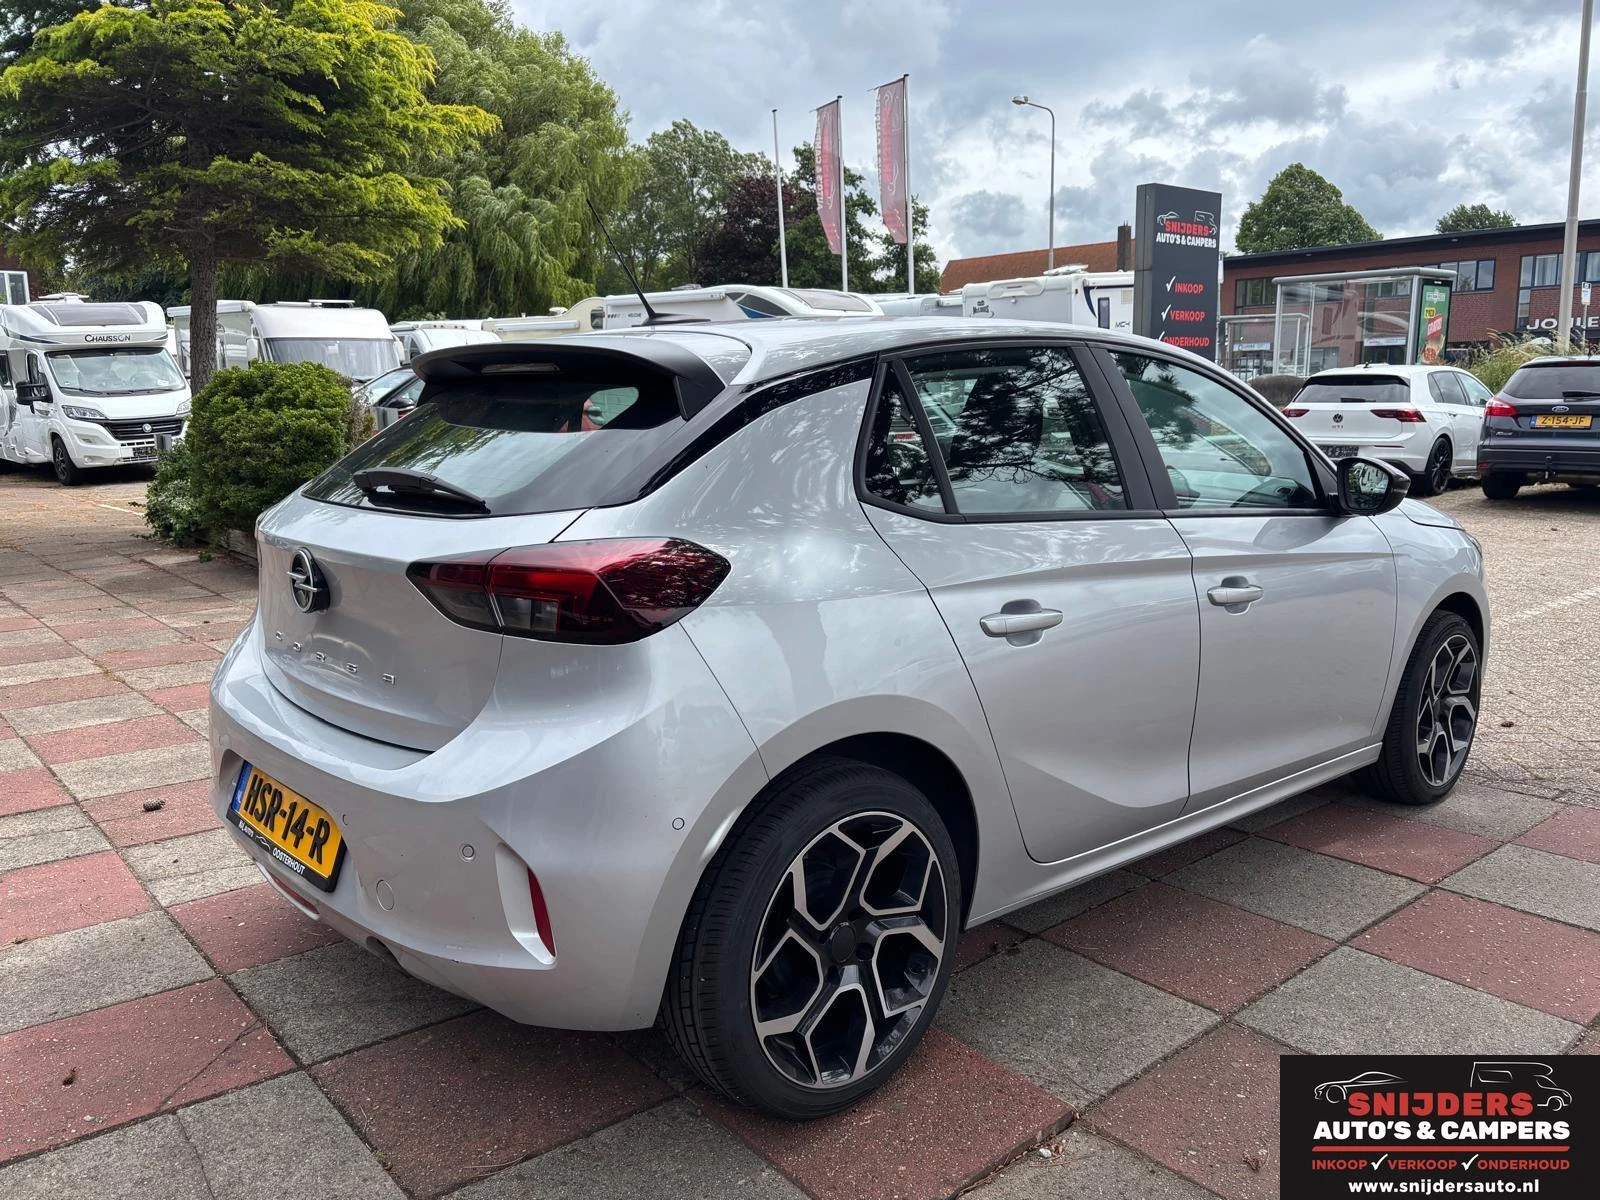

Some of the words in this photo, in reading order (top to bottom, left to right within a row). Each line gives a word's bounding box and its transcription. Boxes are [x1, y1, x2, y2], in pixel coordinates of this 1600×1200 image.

[1165, 220, 1210, 236] SNIJDERS
[1156, 232, 1180, 244] AUTO'S
[1181, 235, 1186, 245] &
[1187, 236, 1216, 248] CAMPERS
[1175, 282, 1204, 294] INKOOP
[1170, 310, 1206, 321] VERKOOP
[84, 334, 130, 342] CHAUSSON
[1541, 416, 1584, 424] Z-154-JF
[276, 630, 395, 685] CORSA
[244, 774, 330, 864] HSR-14-R
[272, 847, 306, 875] OOSTERHOUT
